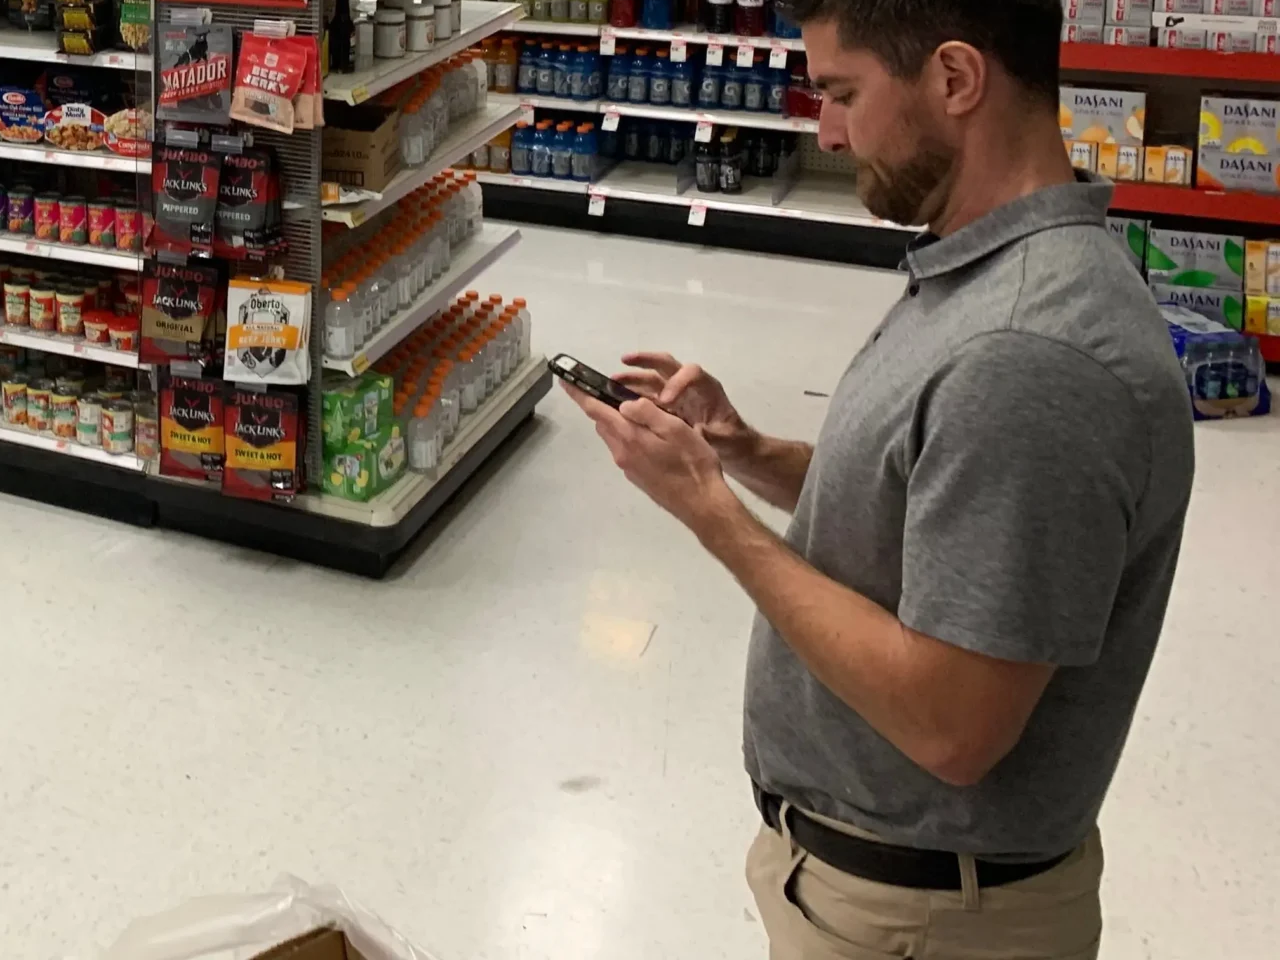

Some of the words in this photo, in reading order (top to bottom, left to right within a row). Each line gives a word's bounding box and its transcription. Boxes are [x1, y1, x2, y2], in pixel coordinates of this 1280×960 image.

[162, 62, 228, 90] MATADOR
[252, 66, 287, 83] BEEF
[243, 75, 291, 95] JERKY
[1074, 94, 1123, 108] DASANI
[1223, 104, 1276, 118] DASANI
[161, 151, 209, 164] JUMBO
[1220, 157, 1272, 173] DASANI
[162, 176, 180, 191] JACK
[162, 203, 199, 216] PEPPERED
[1170, 236, 1220, 252] DASANI
[153, 266, 204, 282] JUMBO
[152, 294, 177, 308] JACK
[250, 296, 281, 310] Oberto
[1170, 292, 1220, 307] DASANI
[156, 320, 194, 334] ORIGINAL
[171, 378, 215, 394] JUMBO
[231, 392, 285, 409] JUMBO
[169, 405, 189, 420] JACK
[234, 422, 256, 436] JACK
[170, 430, 191, 442] SWEET
[197, 434, 212, 445] HOT
[234, 448, 258, 460] SWEET
[266, 450, 282, 462] HOT
